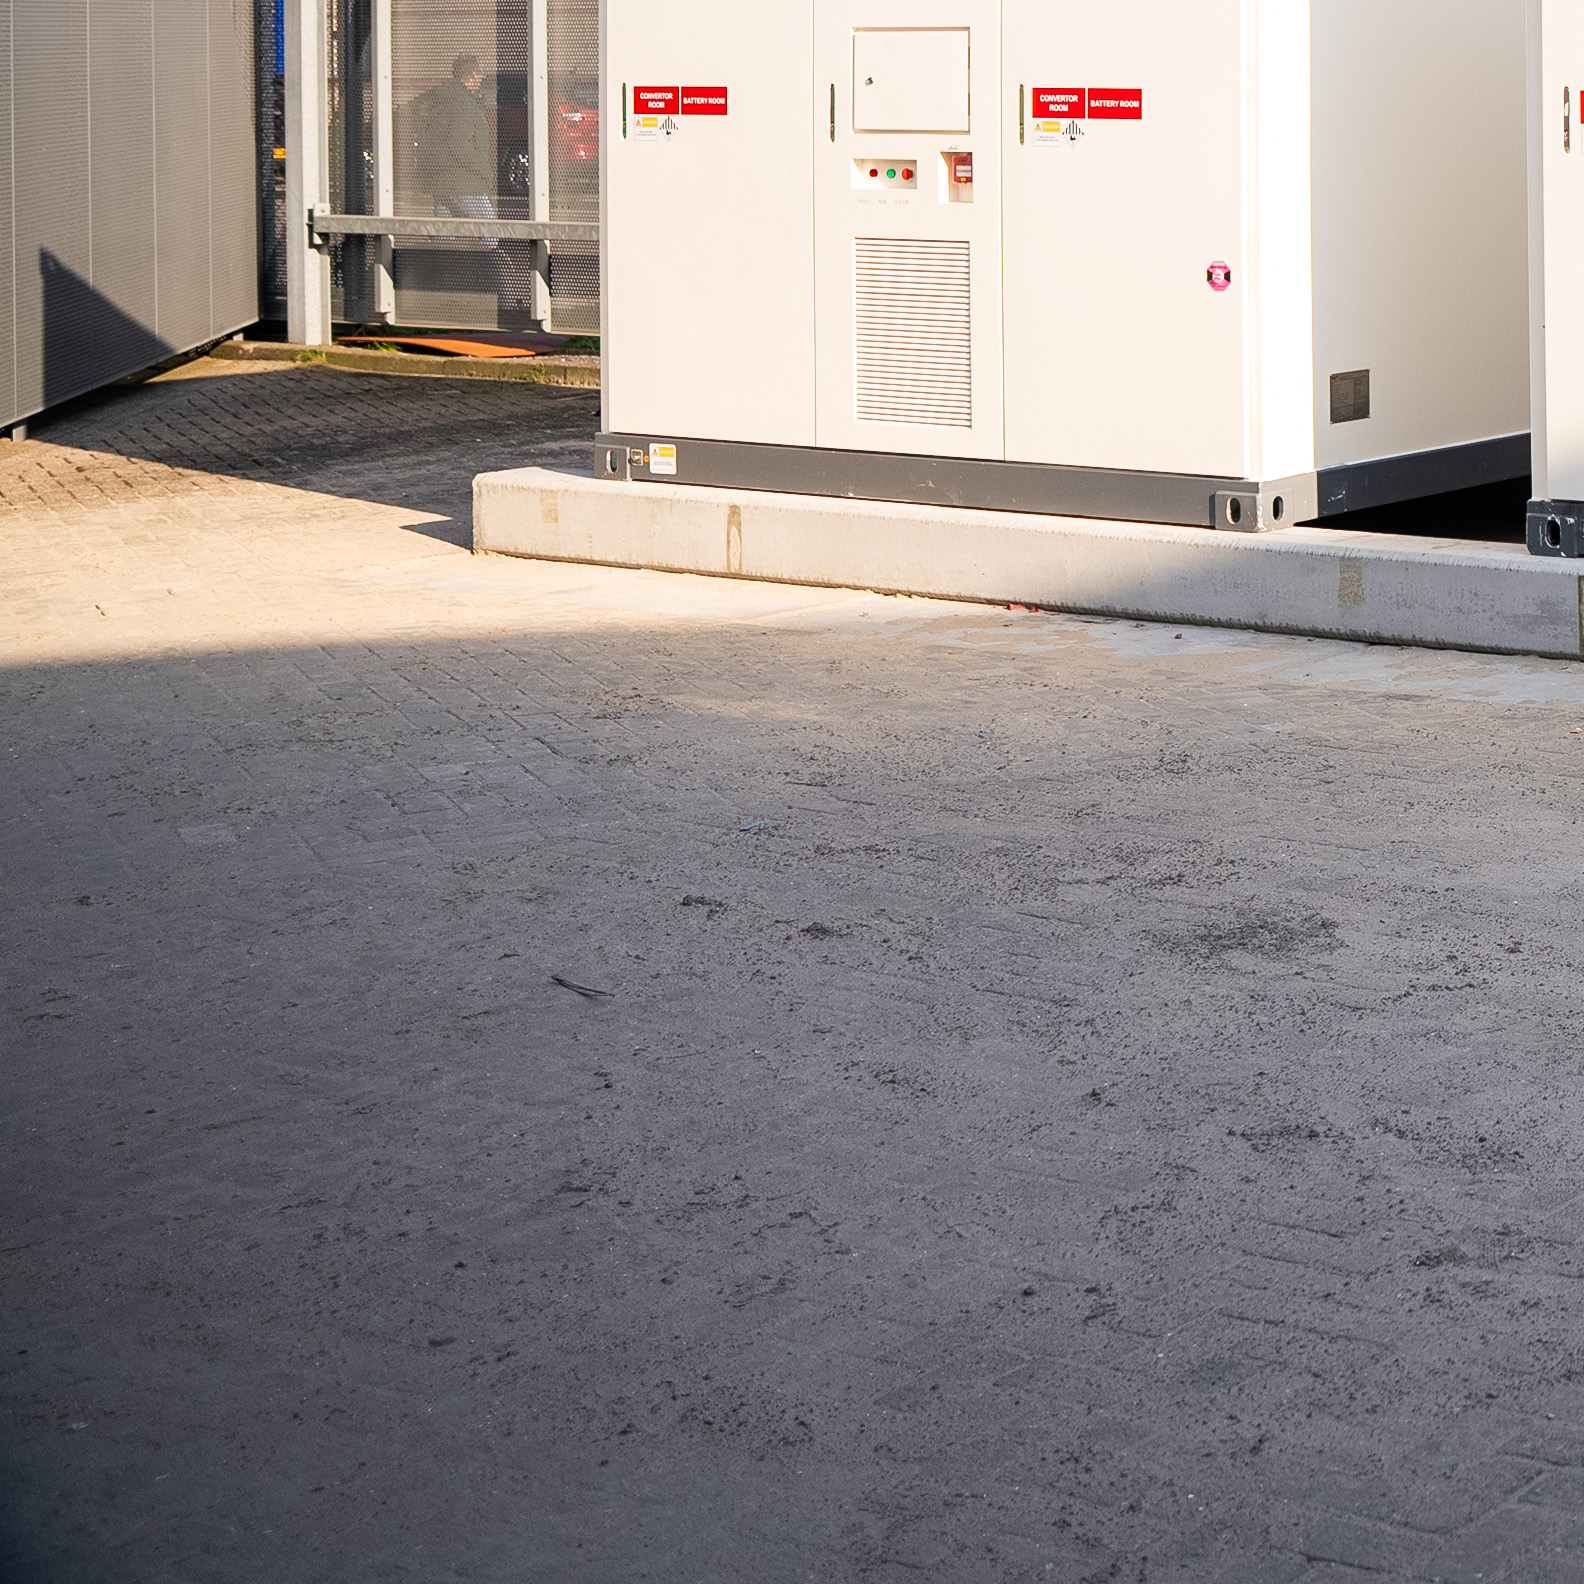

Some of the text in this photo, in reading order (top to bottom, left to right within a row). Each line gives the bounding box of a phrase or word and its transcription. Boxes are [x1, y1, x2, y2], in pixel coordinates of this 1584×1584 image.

[1039, 94, 1078, 102] CONVERTOR
[1090, 99, 1139, 108] BATTERY ROOM
